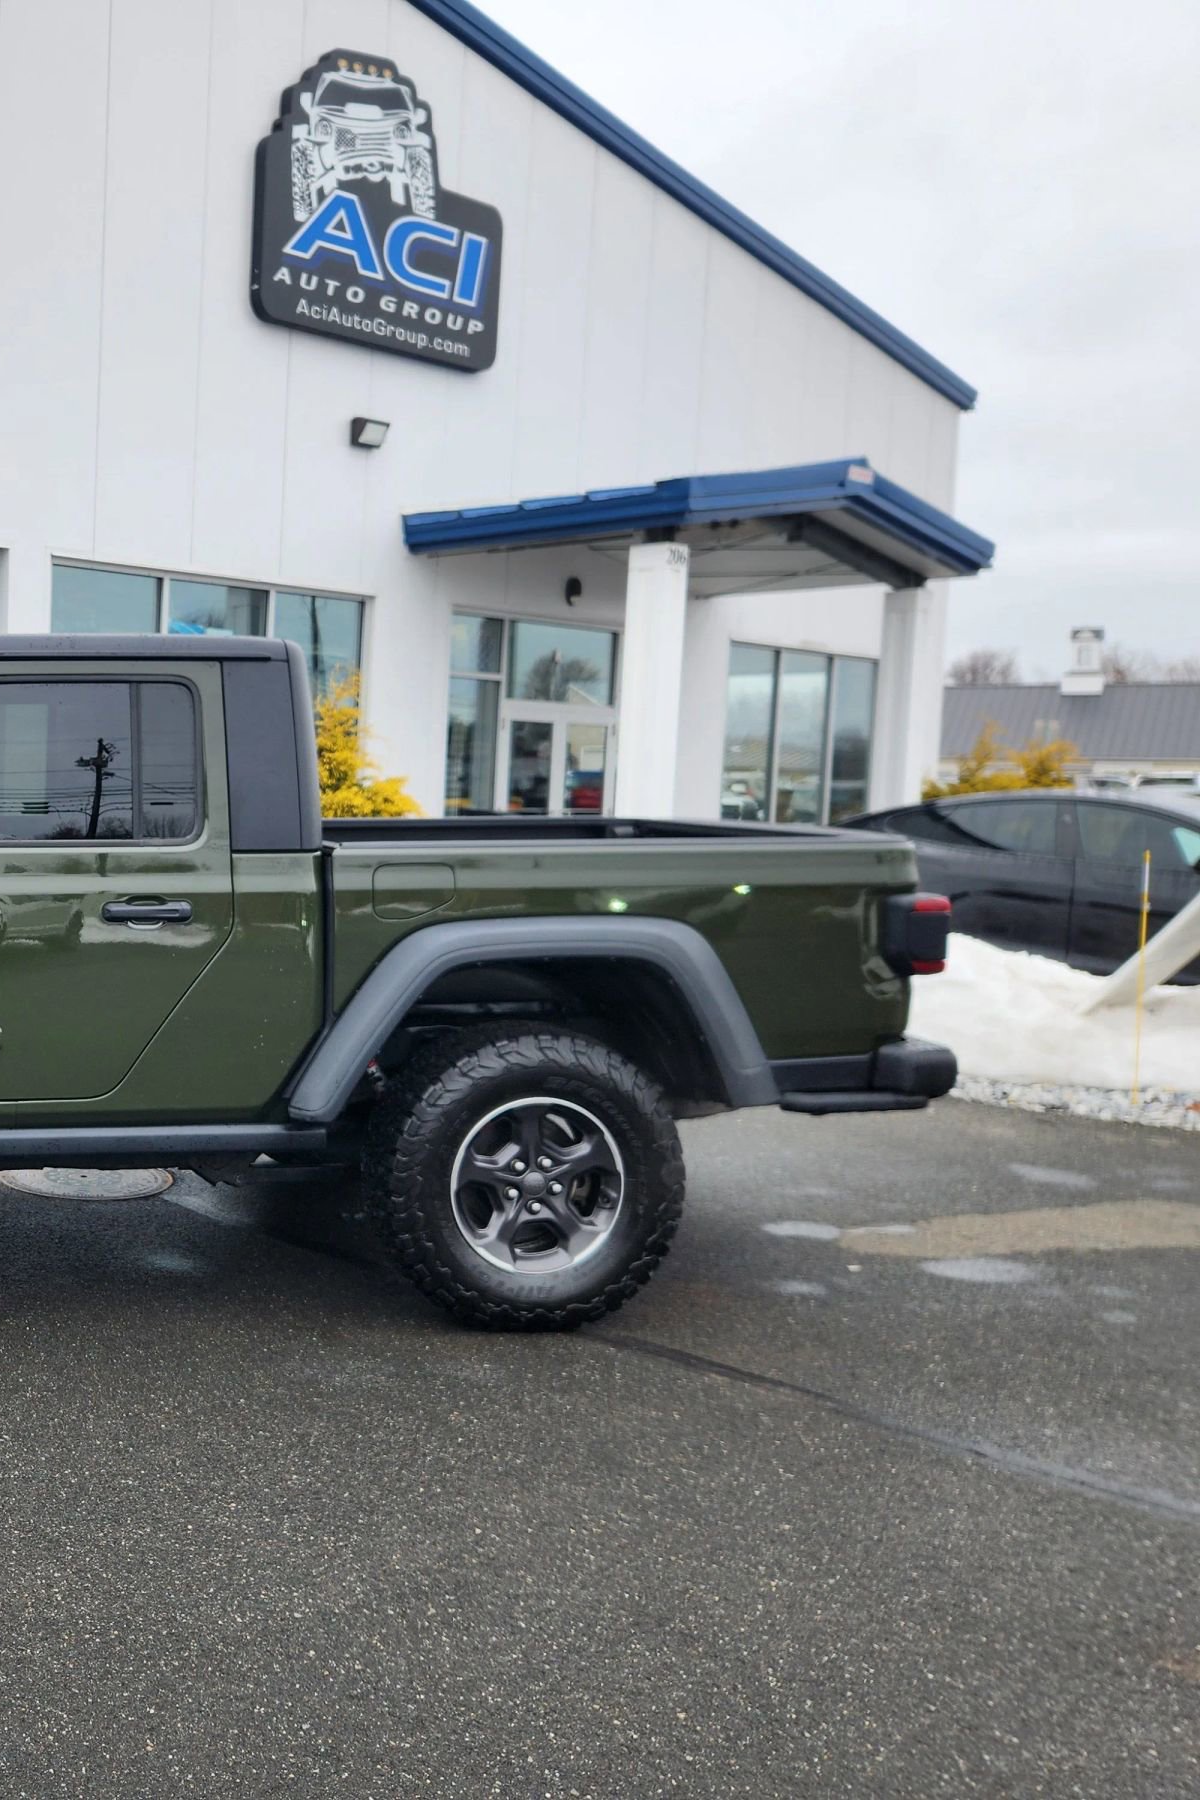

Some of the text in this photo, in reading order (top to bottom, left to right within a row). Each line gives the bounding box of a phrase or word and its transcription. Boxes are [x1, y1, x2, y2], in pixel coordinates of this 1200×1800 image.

[282, 189, 490, 308] ACI
[273, 266, 485, 335] AUTO GROUP
[296, 298, 471, 358] AciAutoGroup.com
